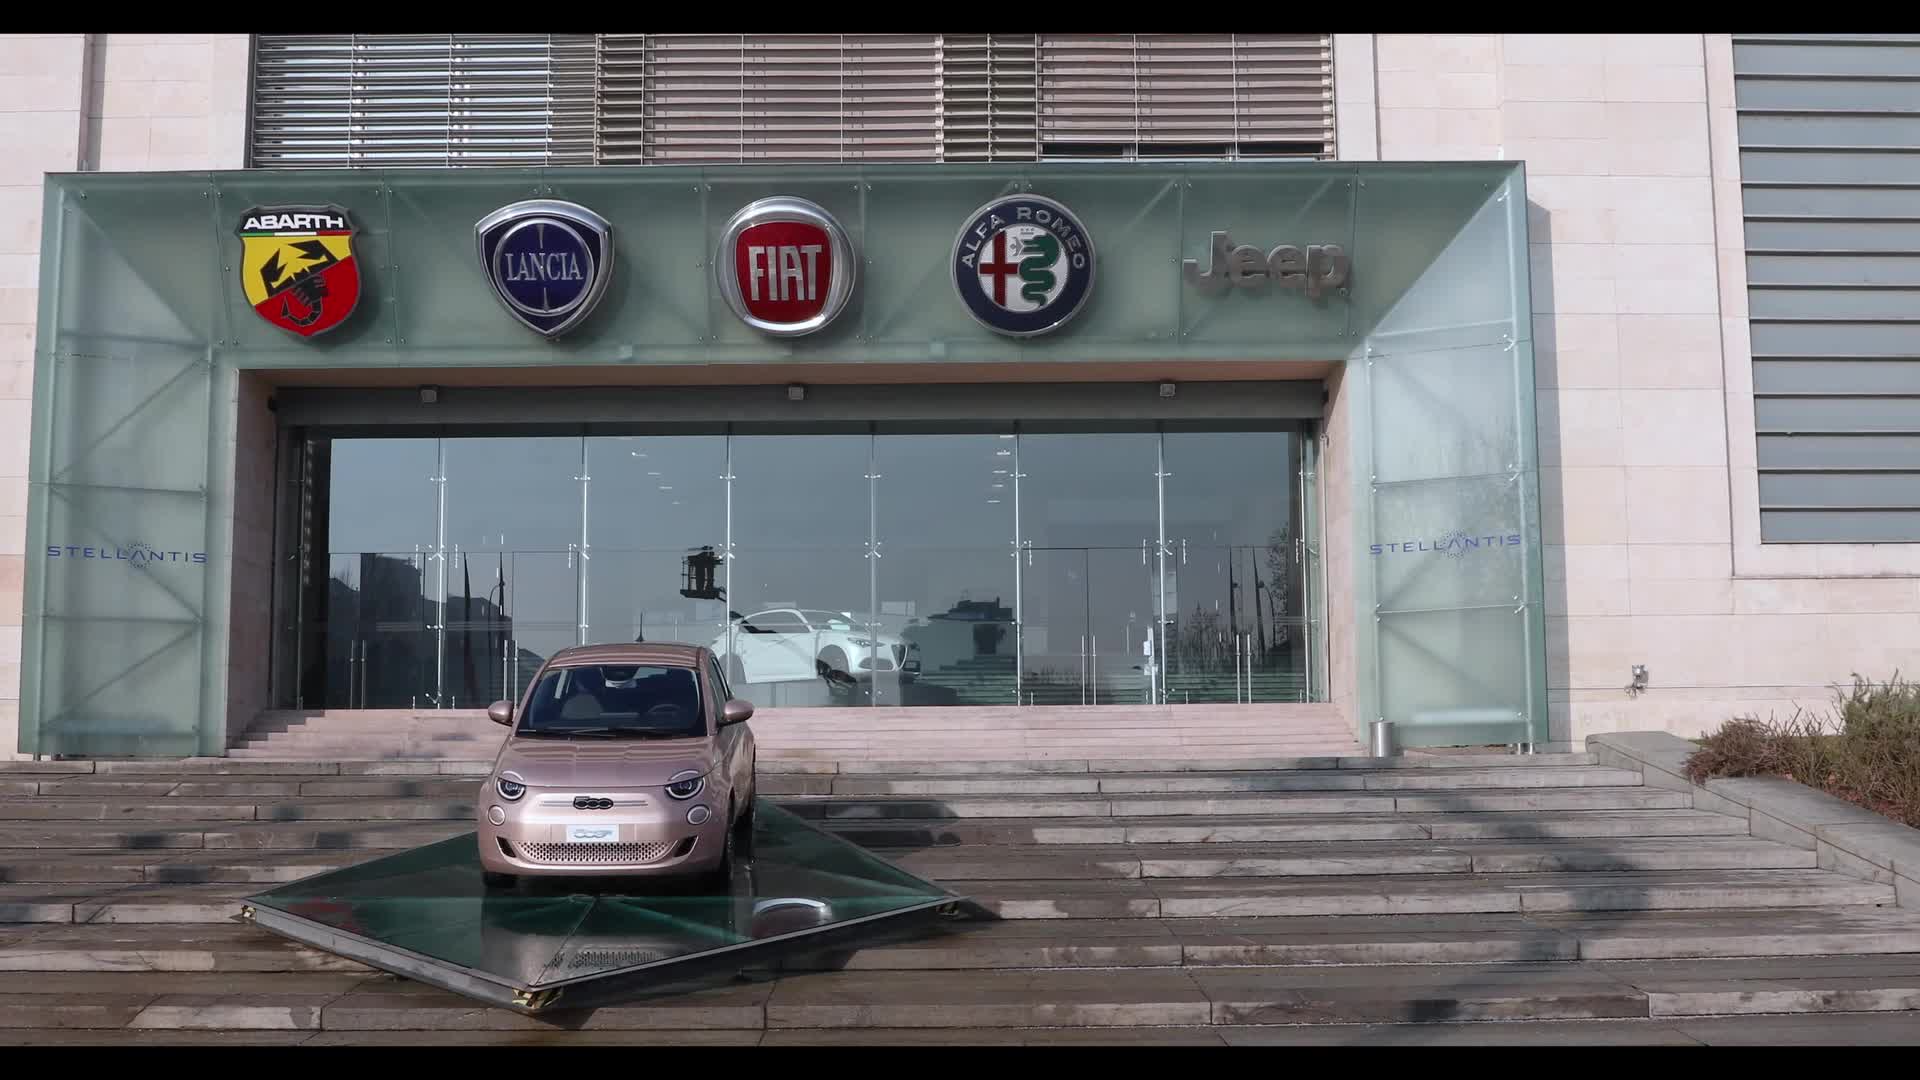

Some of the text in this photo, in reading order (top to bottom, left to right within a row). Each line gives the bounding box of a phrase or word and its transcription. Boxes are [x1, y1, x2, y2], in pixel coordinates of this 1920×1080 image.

[243, 211, 344, 230] ABARTH
[961, 206, 1085, 269] ALFA ROMEO
[504, 252, 584, 282] LANCIA
[748, 244, 823, 302] FIAT
[1183, 230, 1351, 297] Jeep
[47, 546, 208, 563] STELLANTIS
[1369, 533, 1521, 555] STELLANTIS
